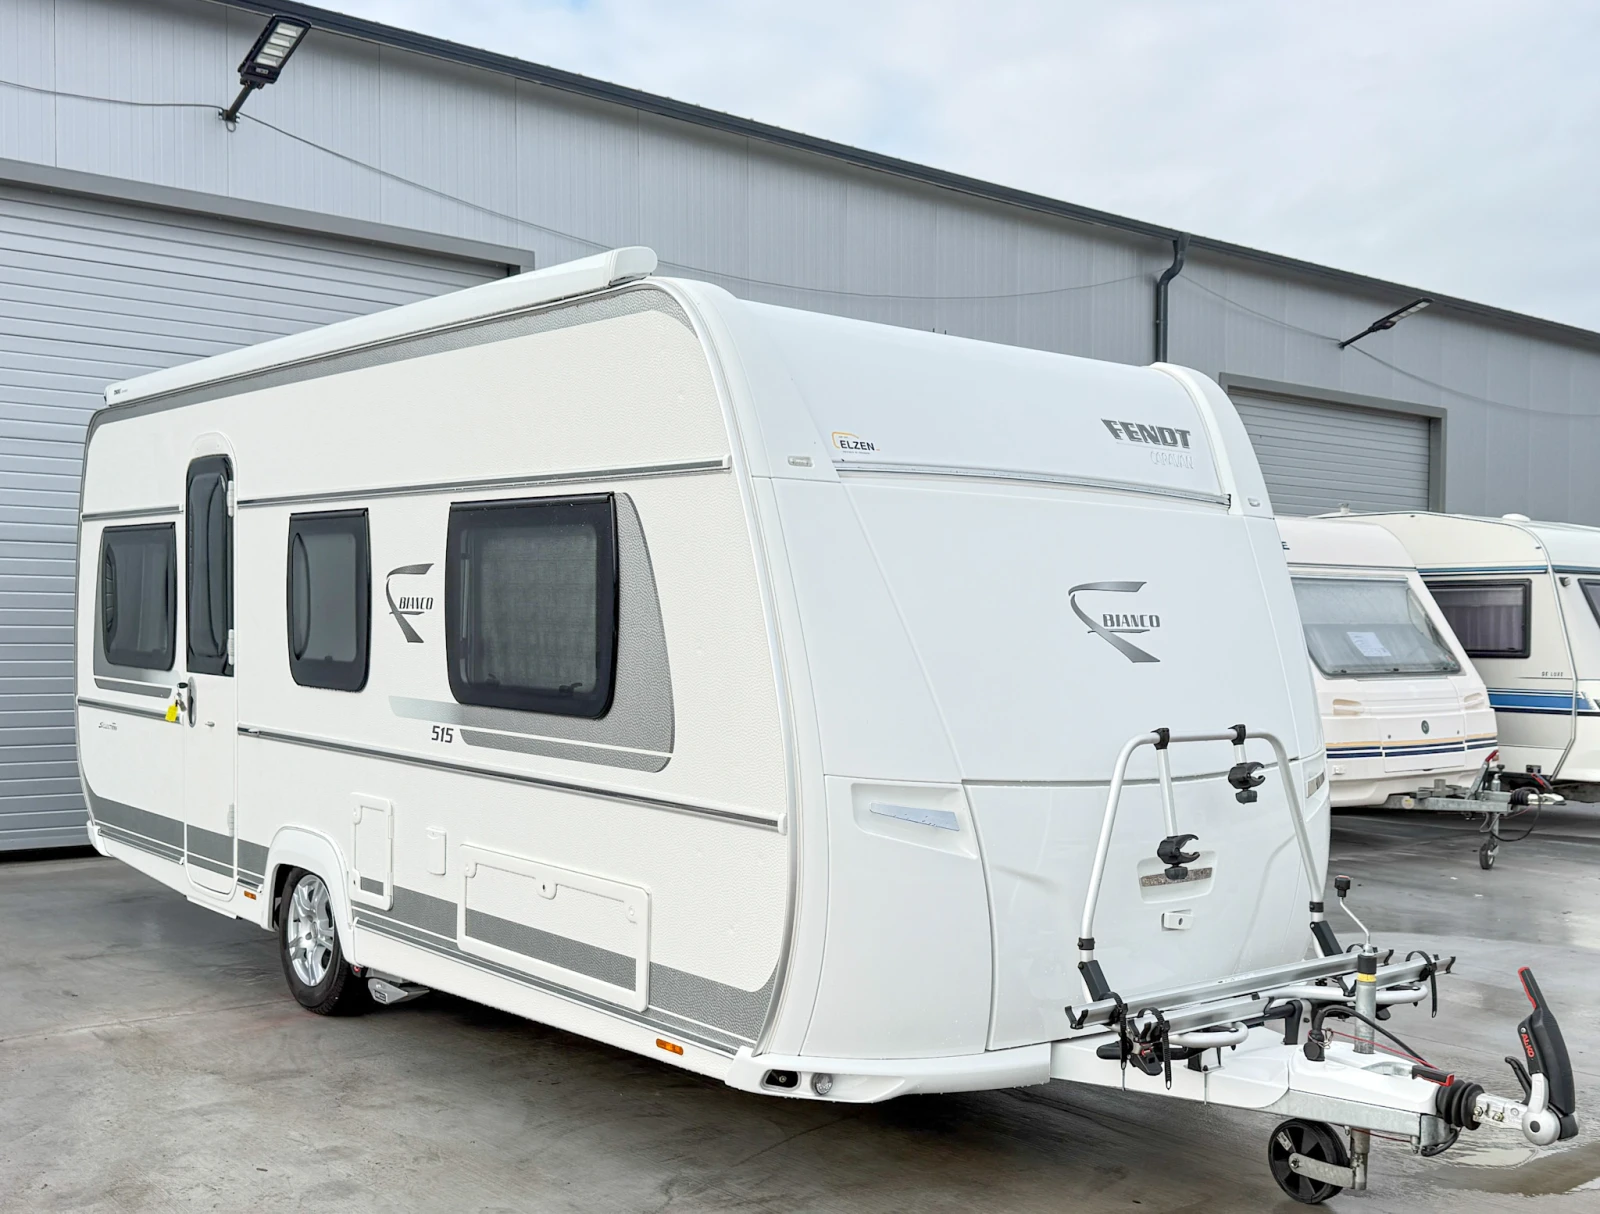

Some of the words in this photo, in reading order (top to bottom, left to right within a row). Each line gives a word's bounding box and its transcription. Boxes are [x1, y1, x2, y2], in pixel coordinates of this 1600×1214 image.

[1101, 418, 1191, 449] FENDT
[839, 439, 875, 451] ELZEN
[399, 596, 434, 610] BIANCO
[1102, 613, 1161, 628] BIANCO
[431, 725, 454, 743] 515
